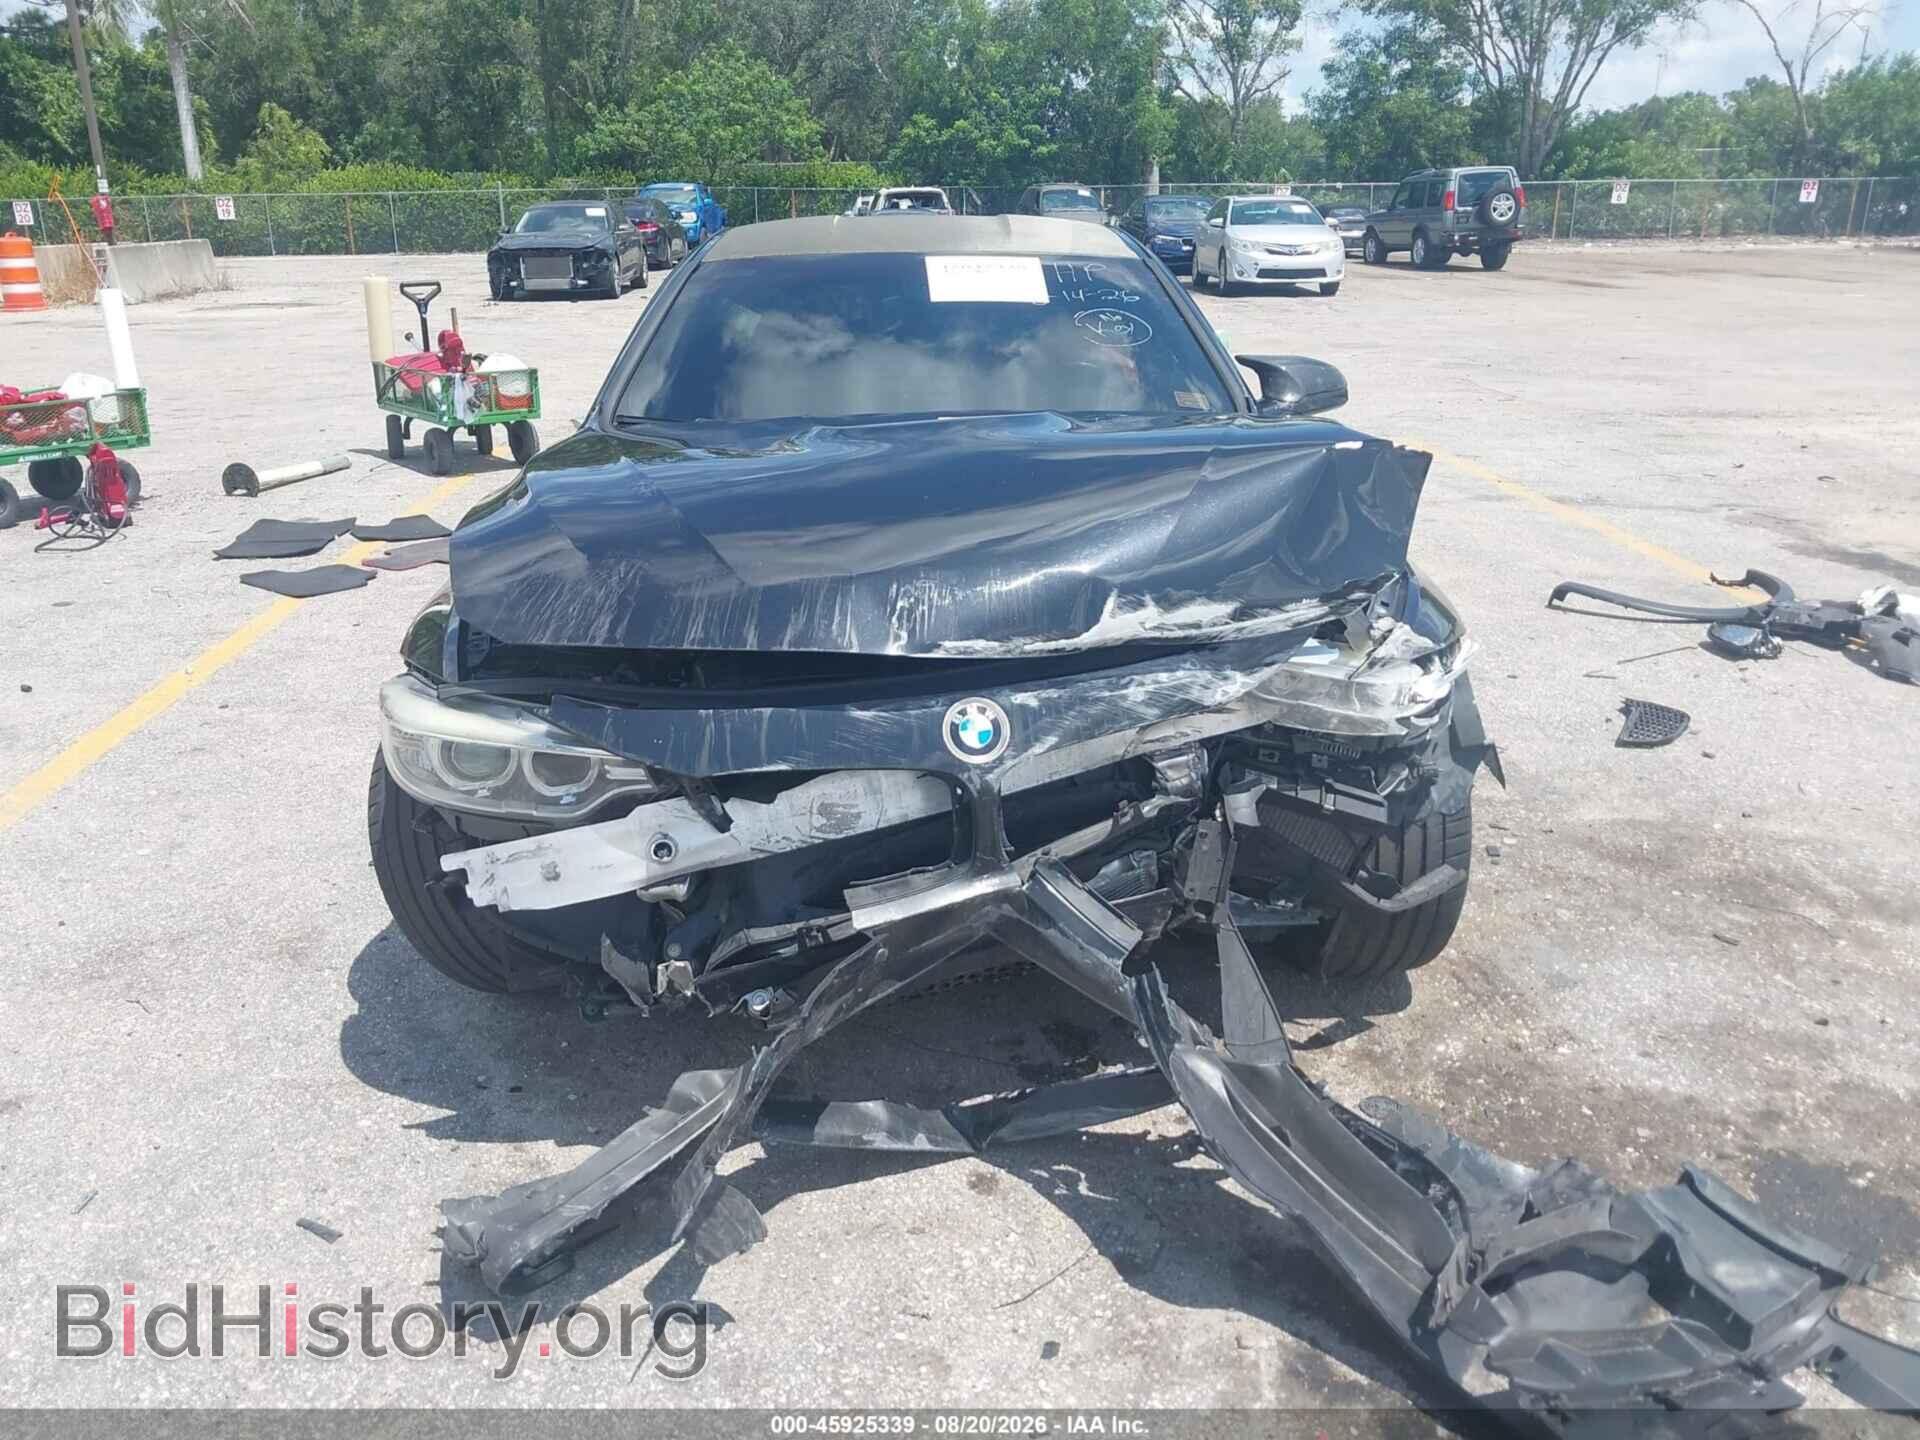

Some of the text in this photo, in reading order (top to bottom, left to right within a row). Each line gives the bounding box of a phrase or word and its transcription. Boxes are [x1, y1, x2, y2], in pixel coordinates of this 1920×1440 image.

[1615, 183, 1628, 192] DZ
[1804, 181, 1817, 190] DZ
[1806, 191, 1812, 200] 7
[15, 202, 30, 212] DZ
[217, 198, 232, 207] DZ
[222, 209, 231, 217] 19
[18, 214, 31, 223] 20
[952, 704, 997, 724] BMW
